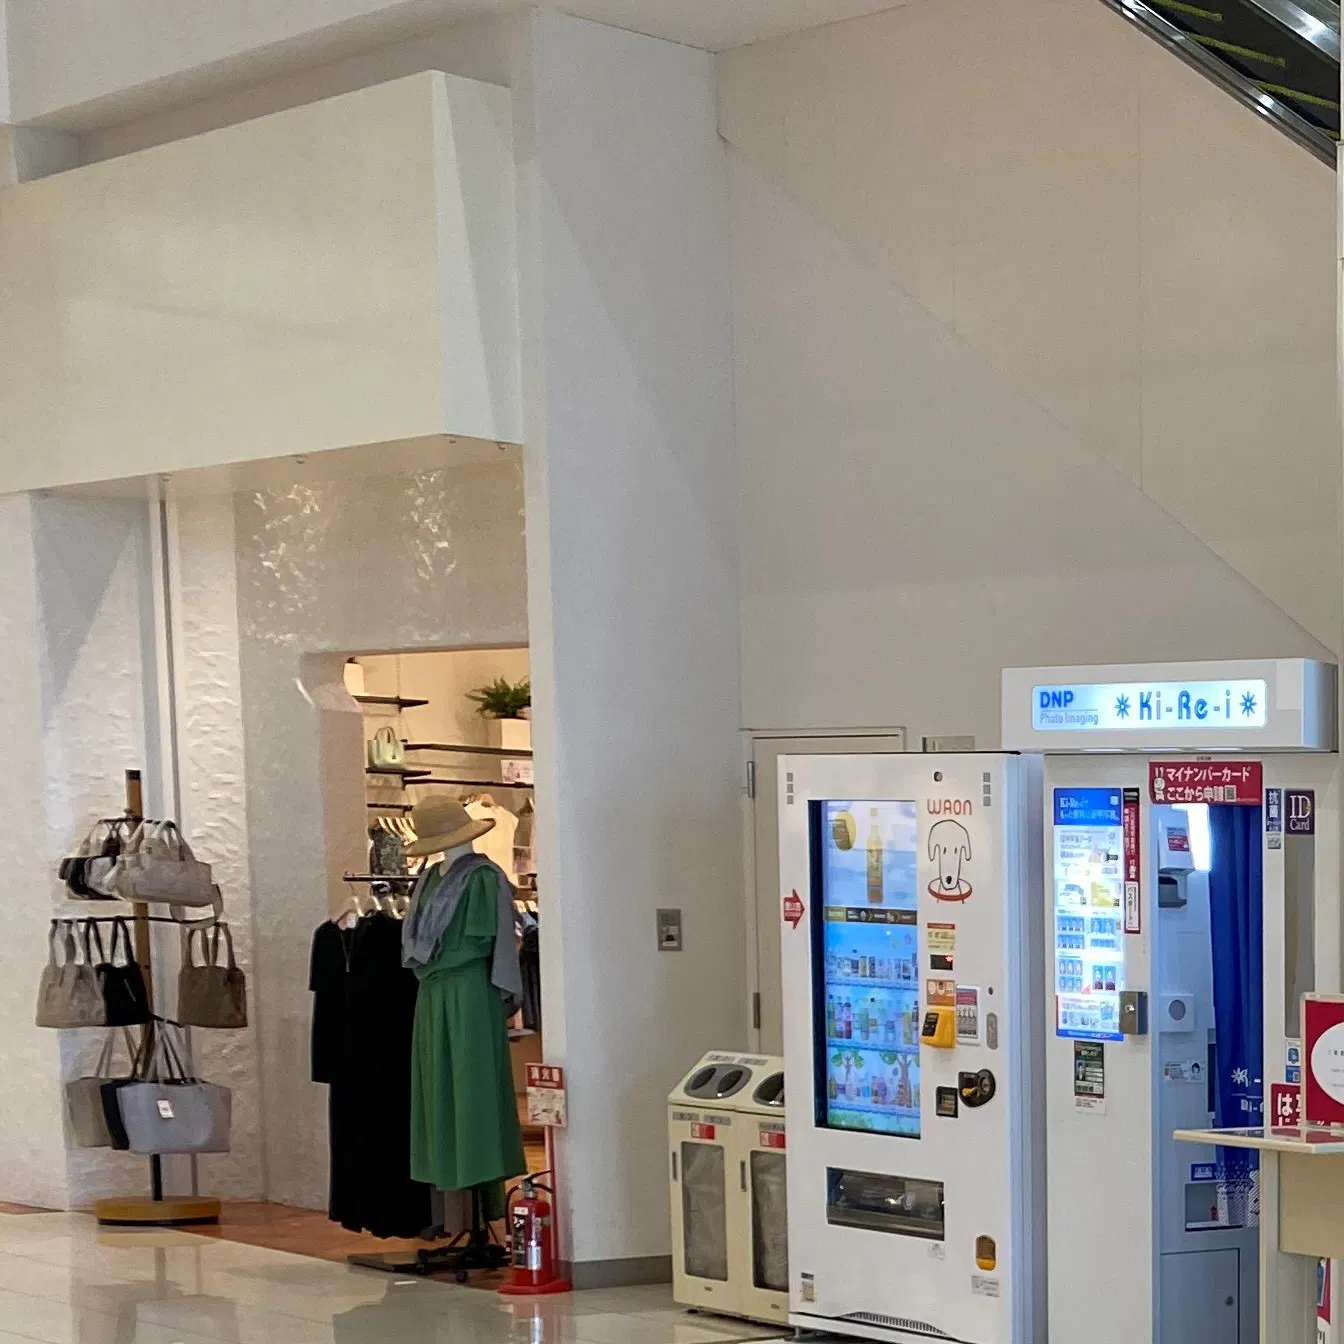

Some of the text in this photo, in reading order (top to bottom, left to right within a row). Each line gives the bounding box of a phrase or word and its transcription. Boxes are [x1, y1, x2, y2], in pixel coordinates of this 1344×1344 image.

[1039, 690, 1074, 709] DNP
[1039, 712, 1099, 725] Photo Imaging
[1166, 767, 1251, 784] マイナンバーカード
[926, 799, 973, 816] WAON
[1290, 795, 1312, 819] ID
[1289, 818, 1310, 831] Card
